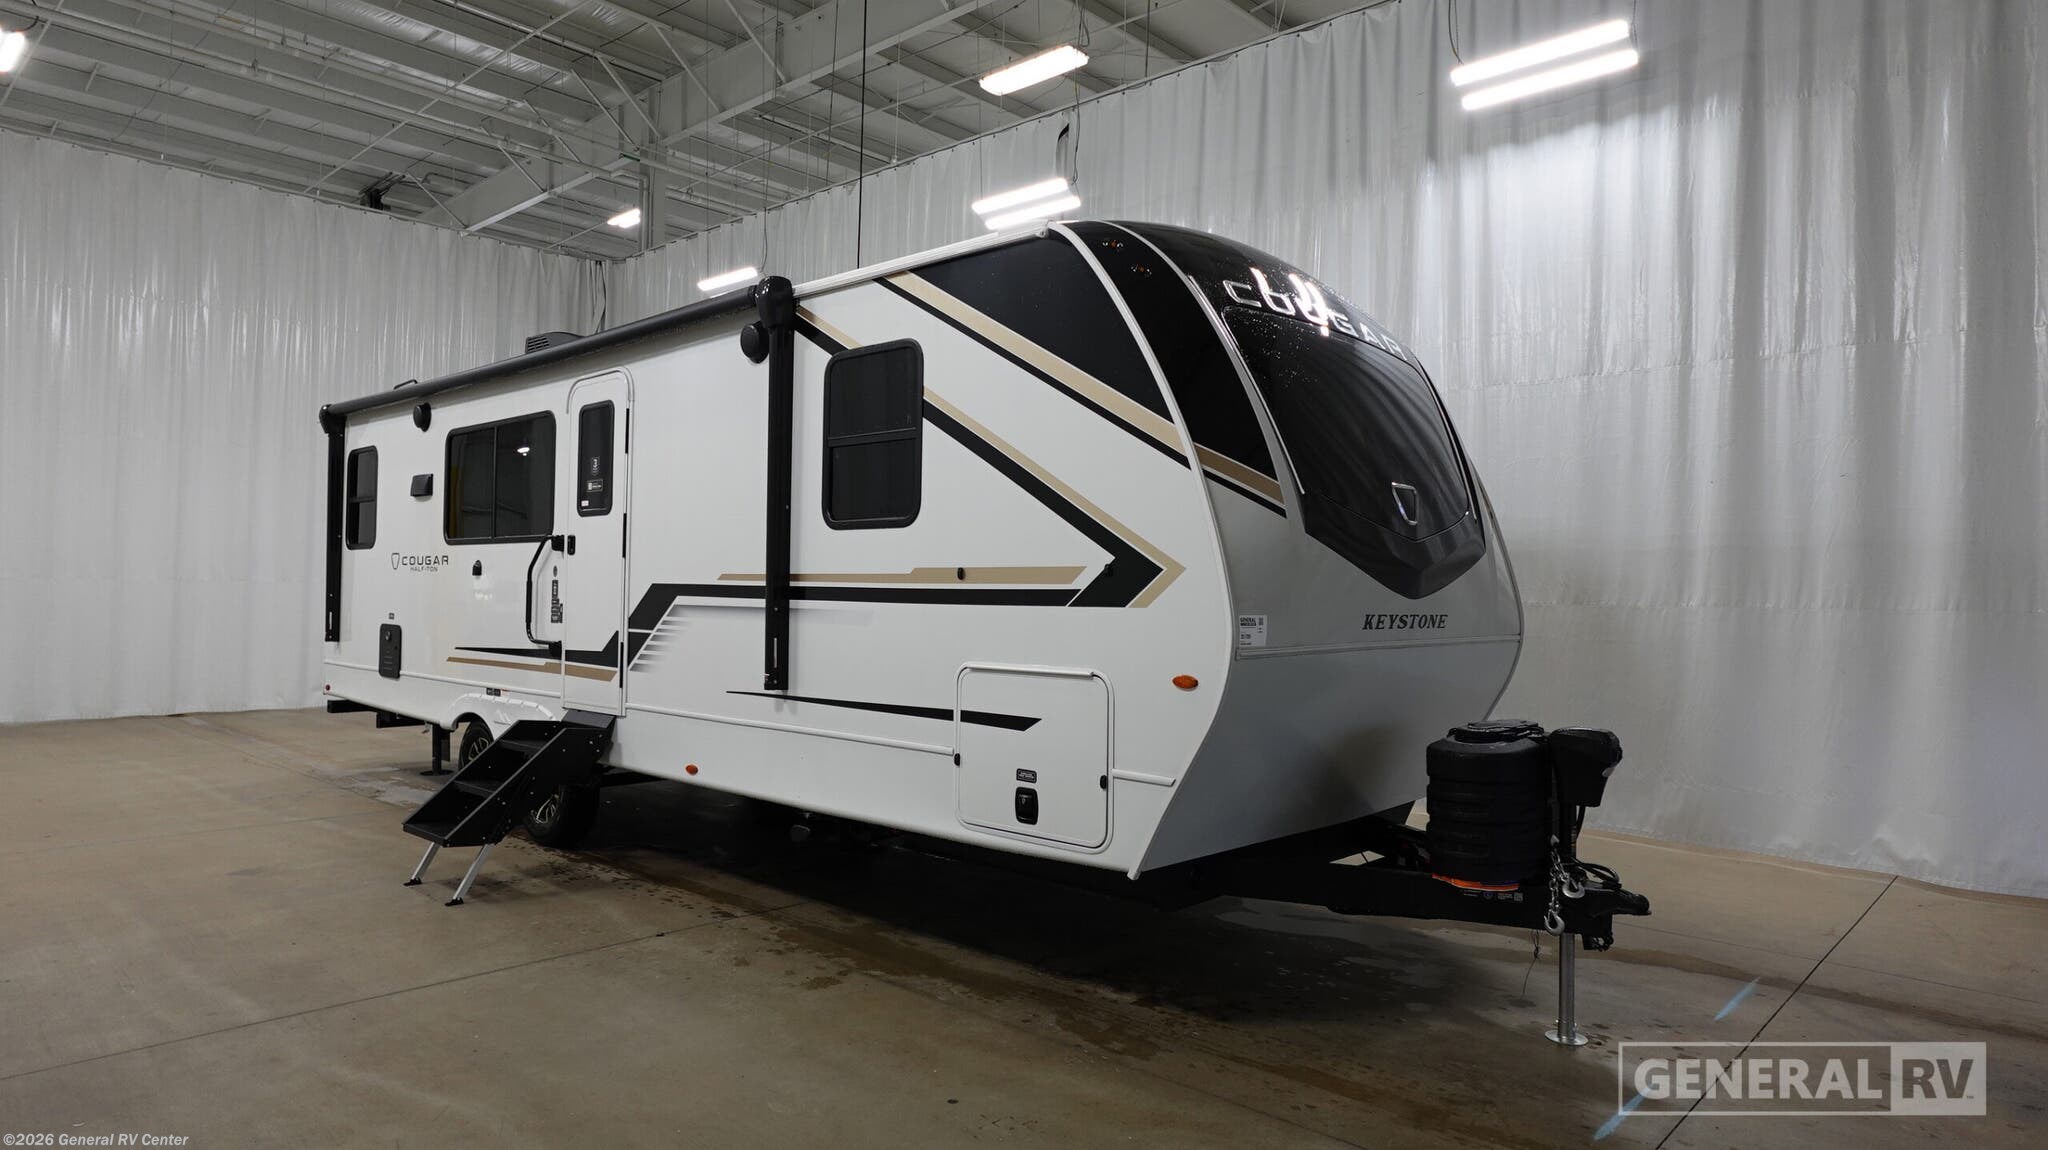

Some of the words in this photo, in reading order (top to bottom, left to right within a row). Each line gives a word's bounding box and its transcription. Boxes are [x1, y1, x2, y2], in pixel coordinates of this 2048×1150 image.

[1223, 279, 1408, 361] COUGAR
[402, 555, 449, 566] COUGAR
[1362, 614, 1448, 630] KEYSTONE
